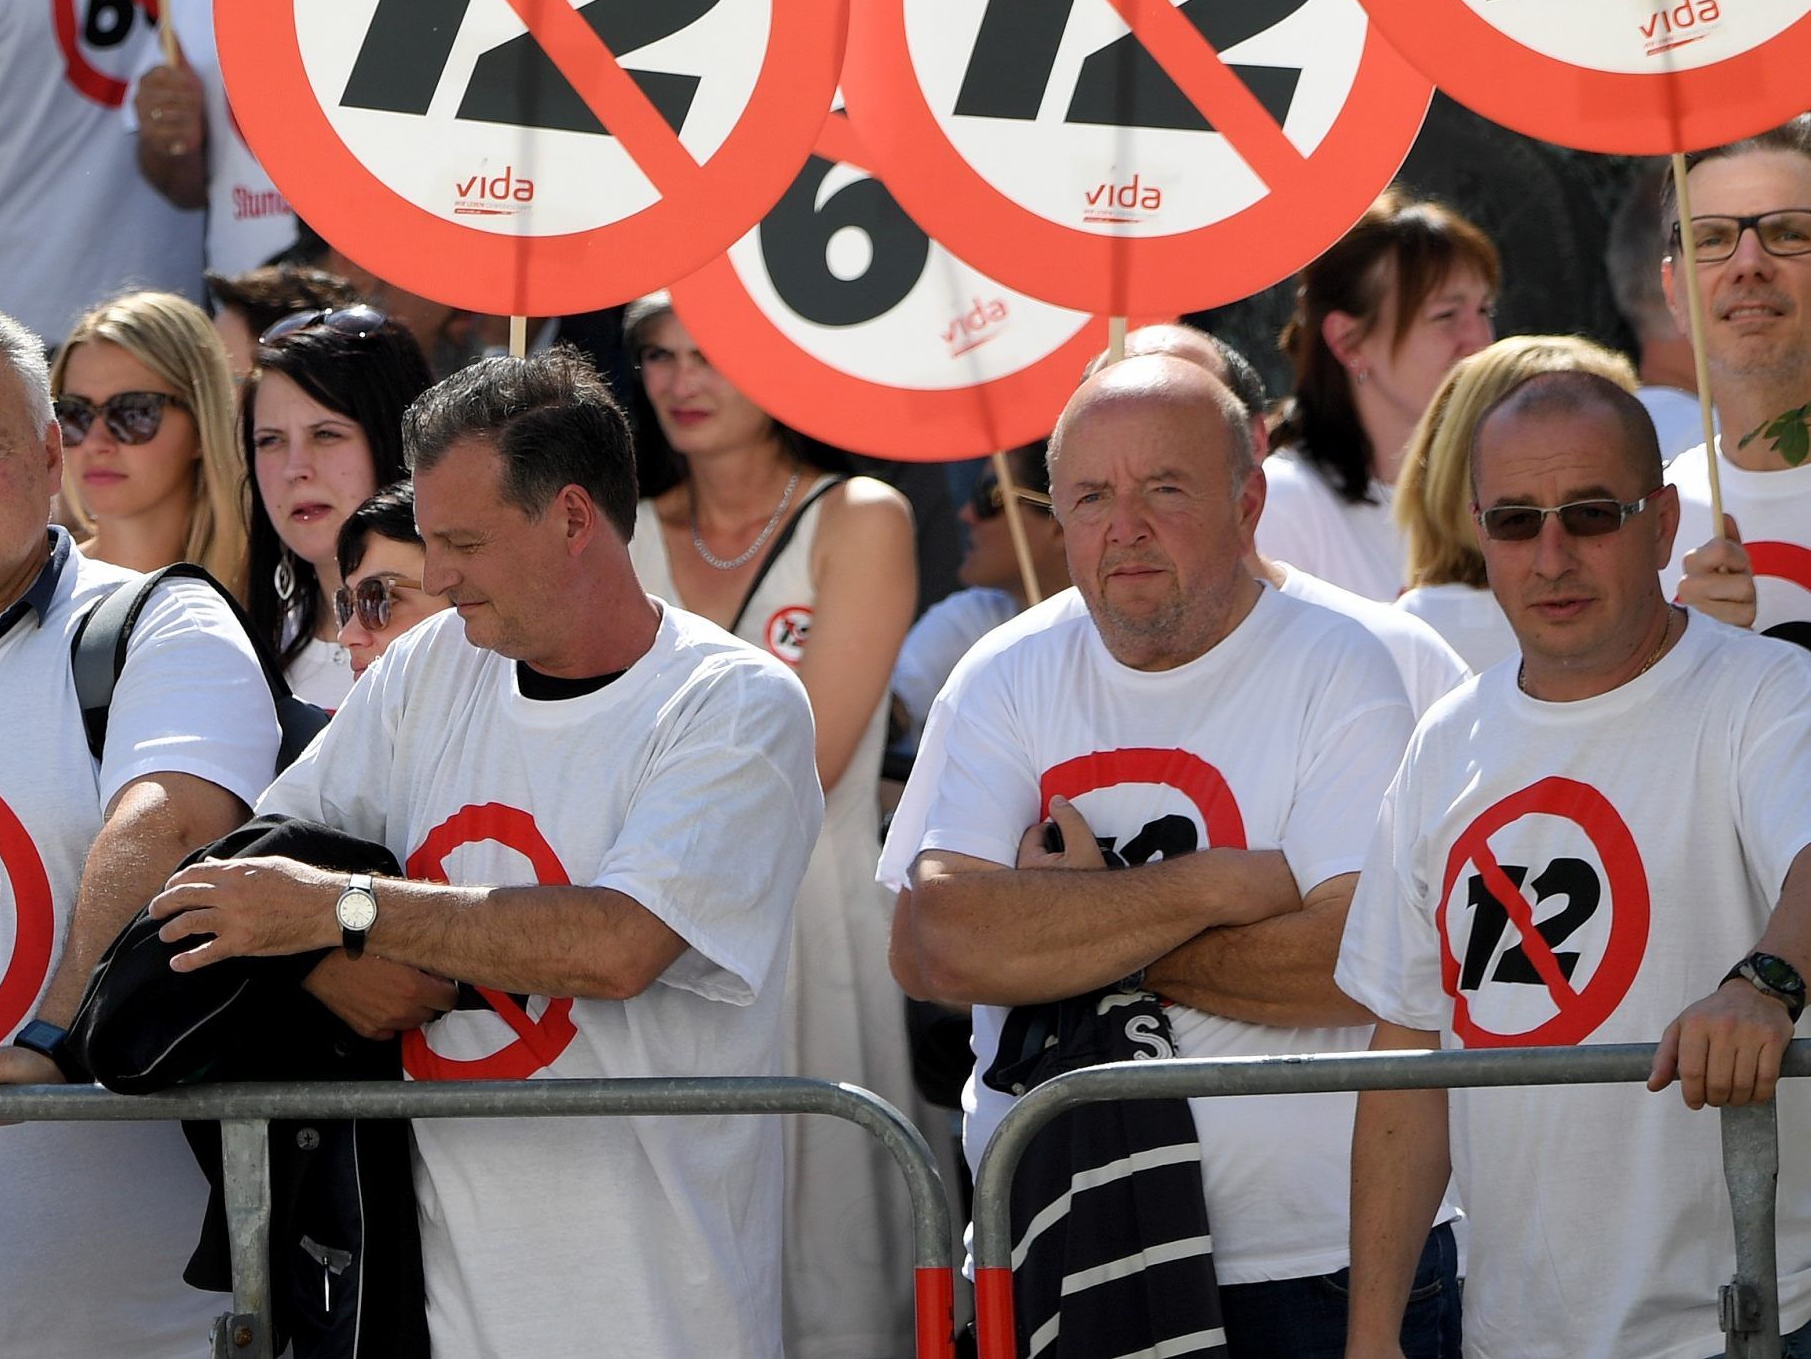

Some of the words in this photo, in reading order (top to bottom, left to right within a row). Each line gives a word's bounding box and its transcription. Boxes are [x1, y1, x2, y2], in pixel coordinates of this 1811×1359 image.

[455, 165, 535, 202] vida
[760, 108, 929, 327] 6
[1084, 173, 1162, 210] vida
[1457, 857, 1604, 992] 12
